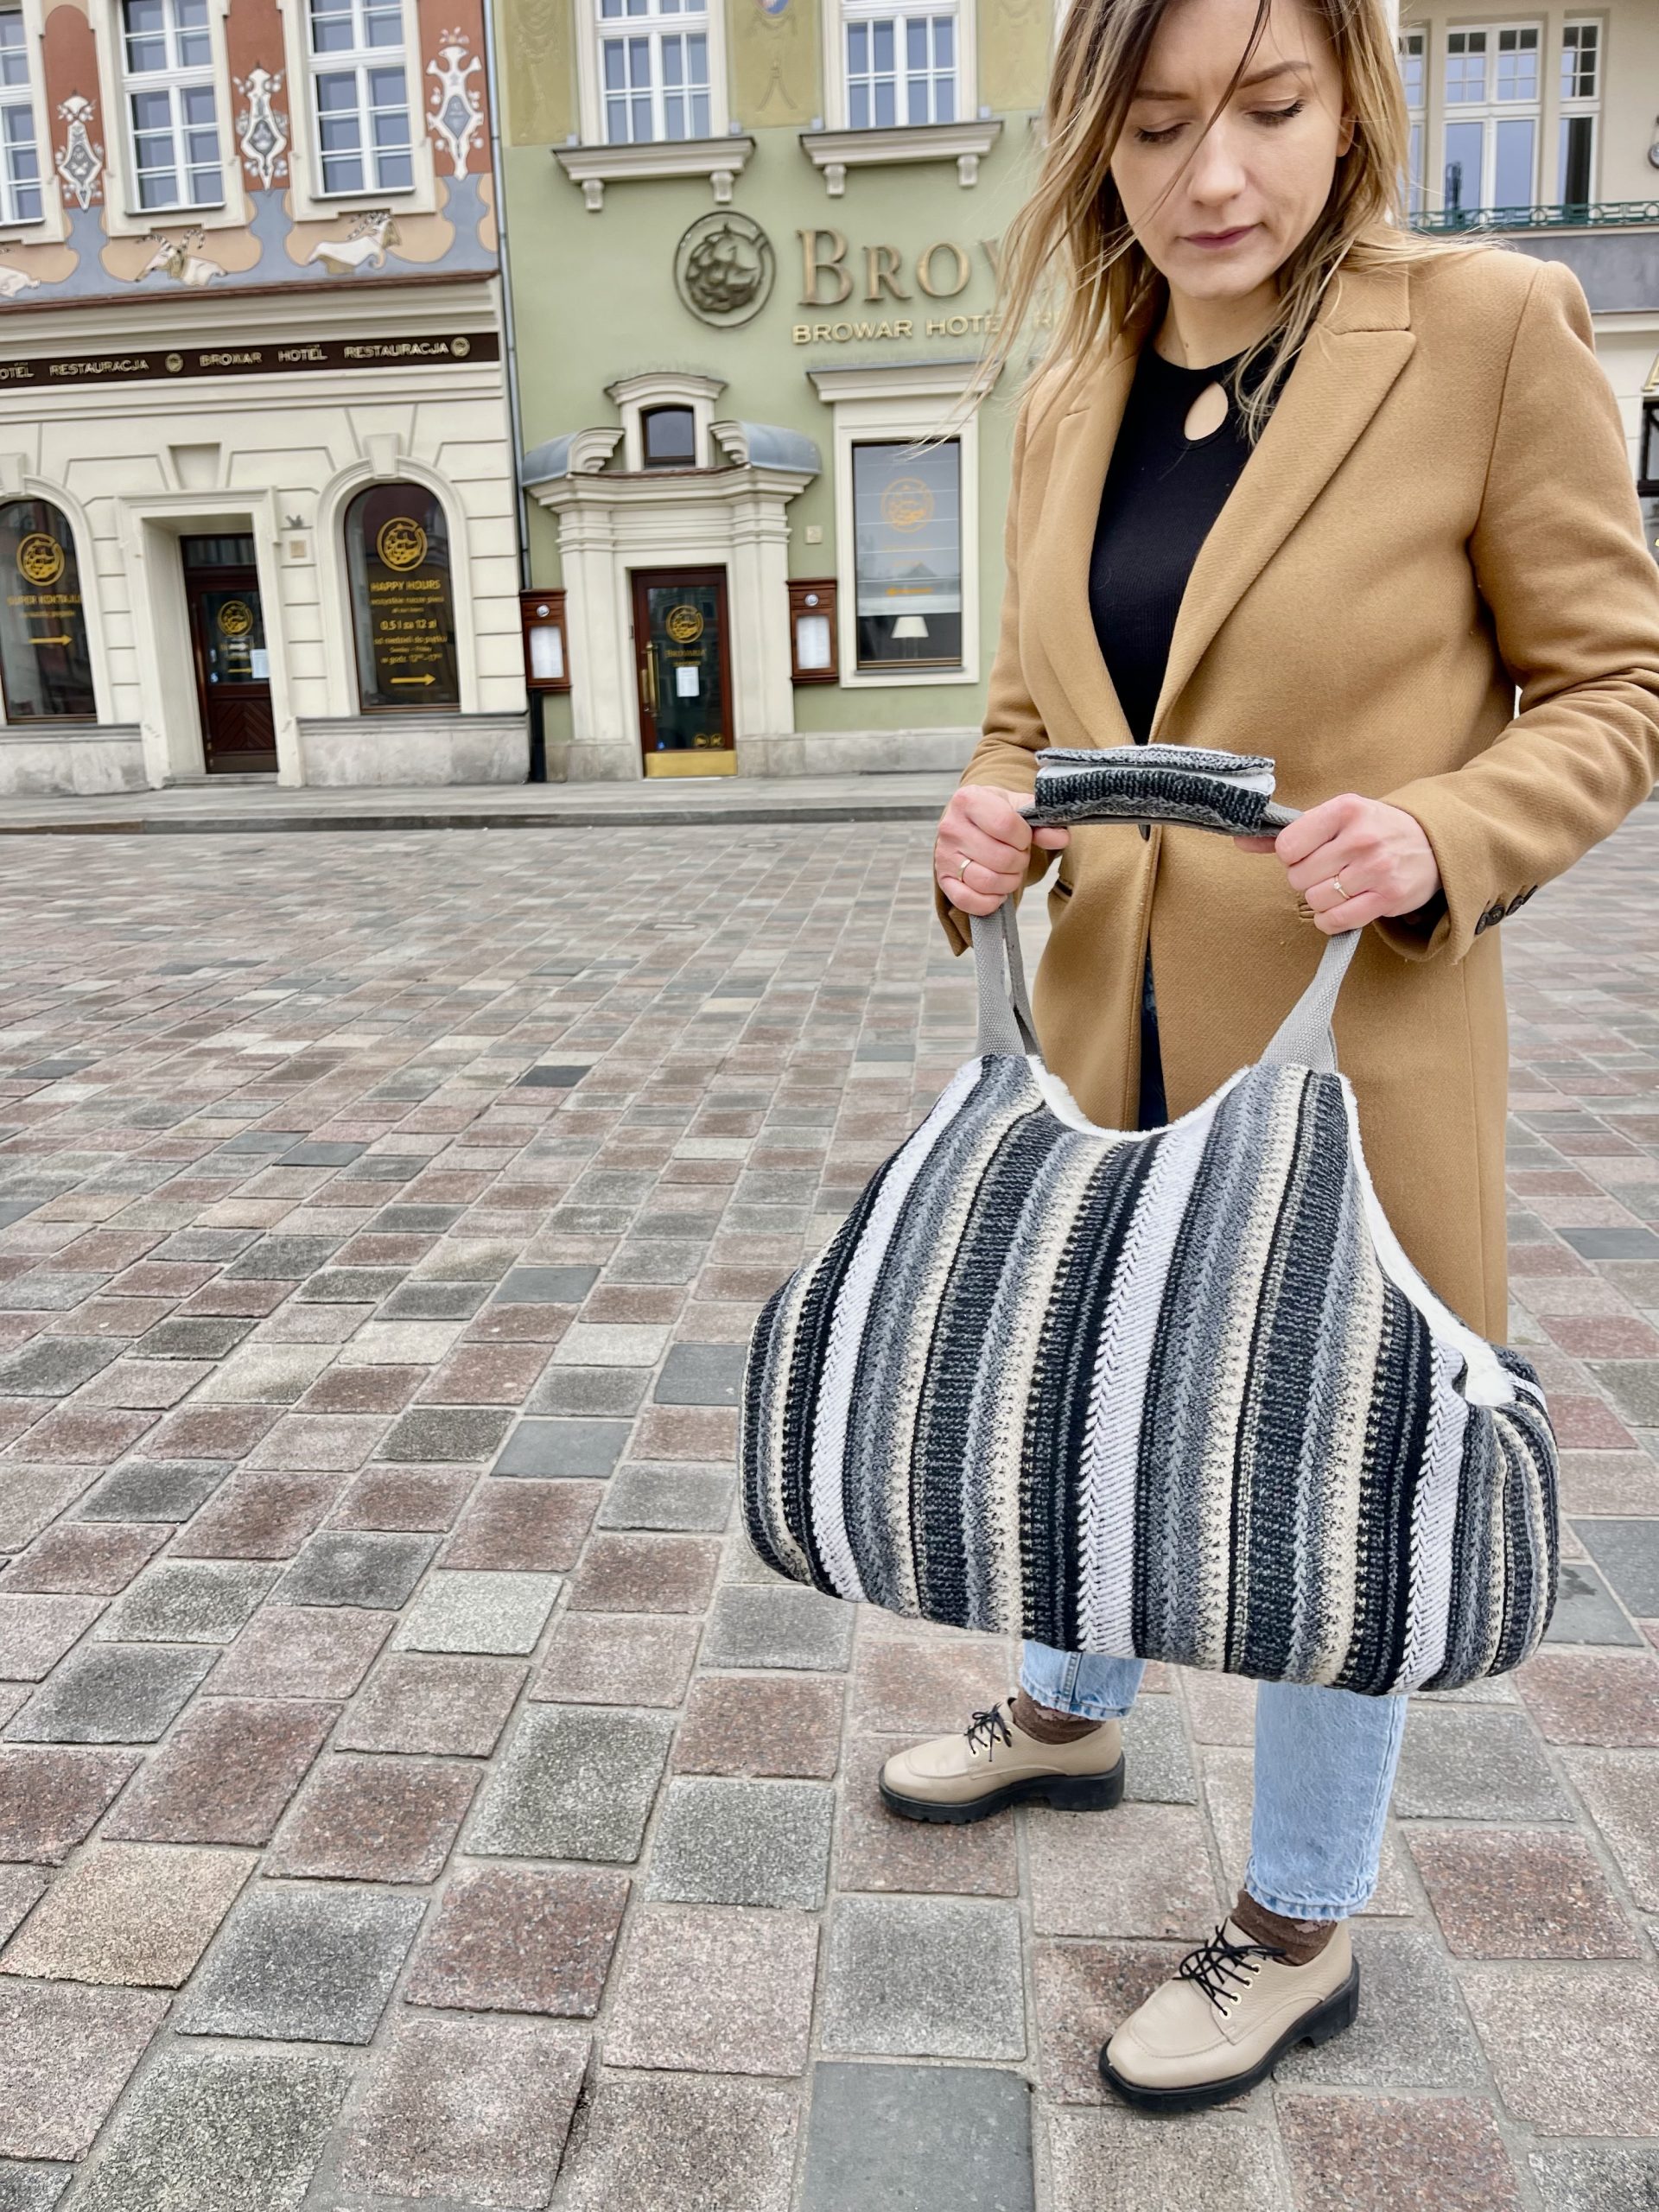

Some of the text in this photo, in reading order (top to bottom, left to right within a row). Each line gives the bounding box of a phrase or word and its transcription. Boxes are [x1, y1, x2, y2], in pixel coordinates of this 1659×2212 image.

[791, 319, 912, 344] BROWAR
[925, 313, 1014, 336] HOTE
[49, 359, 149, 377] RESTAURACJA
[199, 352, 263, 367] BROWAR
[277, 348, 328, 362] HOTEL
[344, 342, 449, 359] RESTAURACJA
[370, 580, 442, 592] HAPPY HOURS
